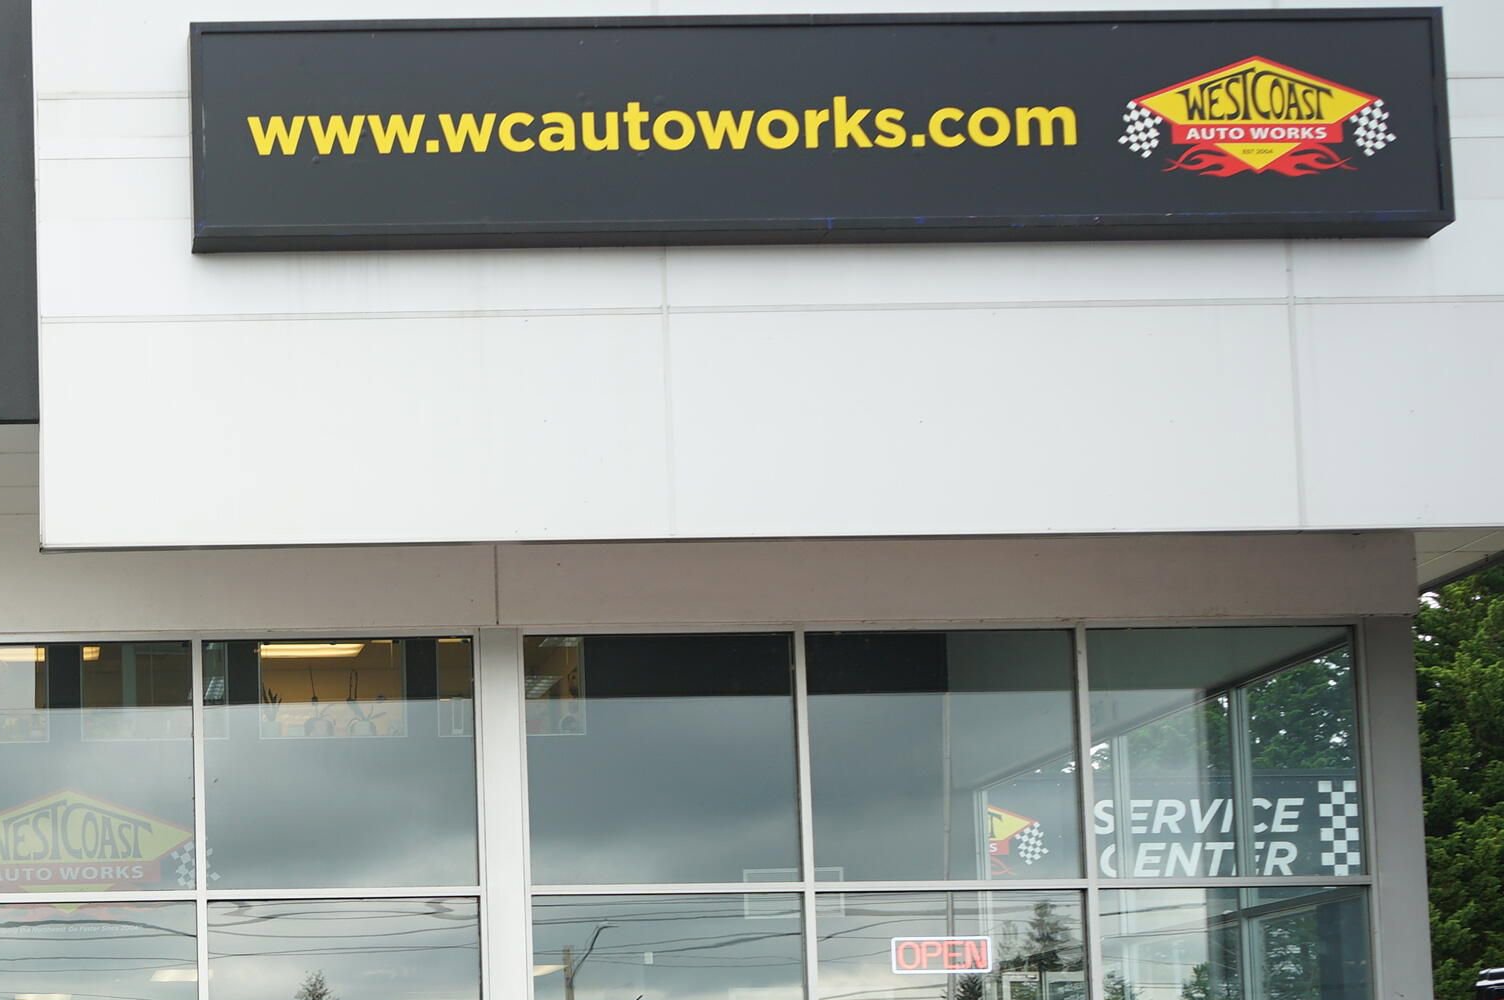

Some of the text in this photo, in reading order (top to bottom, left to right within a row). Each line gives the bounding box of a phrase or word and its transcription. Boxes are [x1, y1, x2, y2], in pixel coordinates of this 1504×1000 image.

[247, 95, 1078, 156] www.wcautoworks.com
[1186, 126, 1328, 140] AUTO WORKS
[59, 865, 145, 881] WORKS
[897, 940, 987, 970] OPEN
